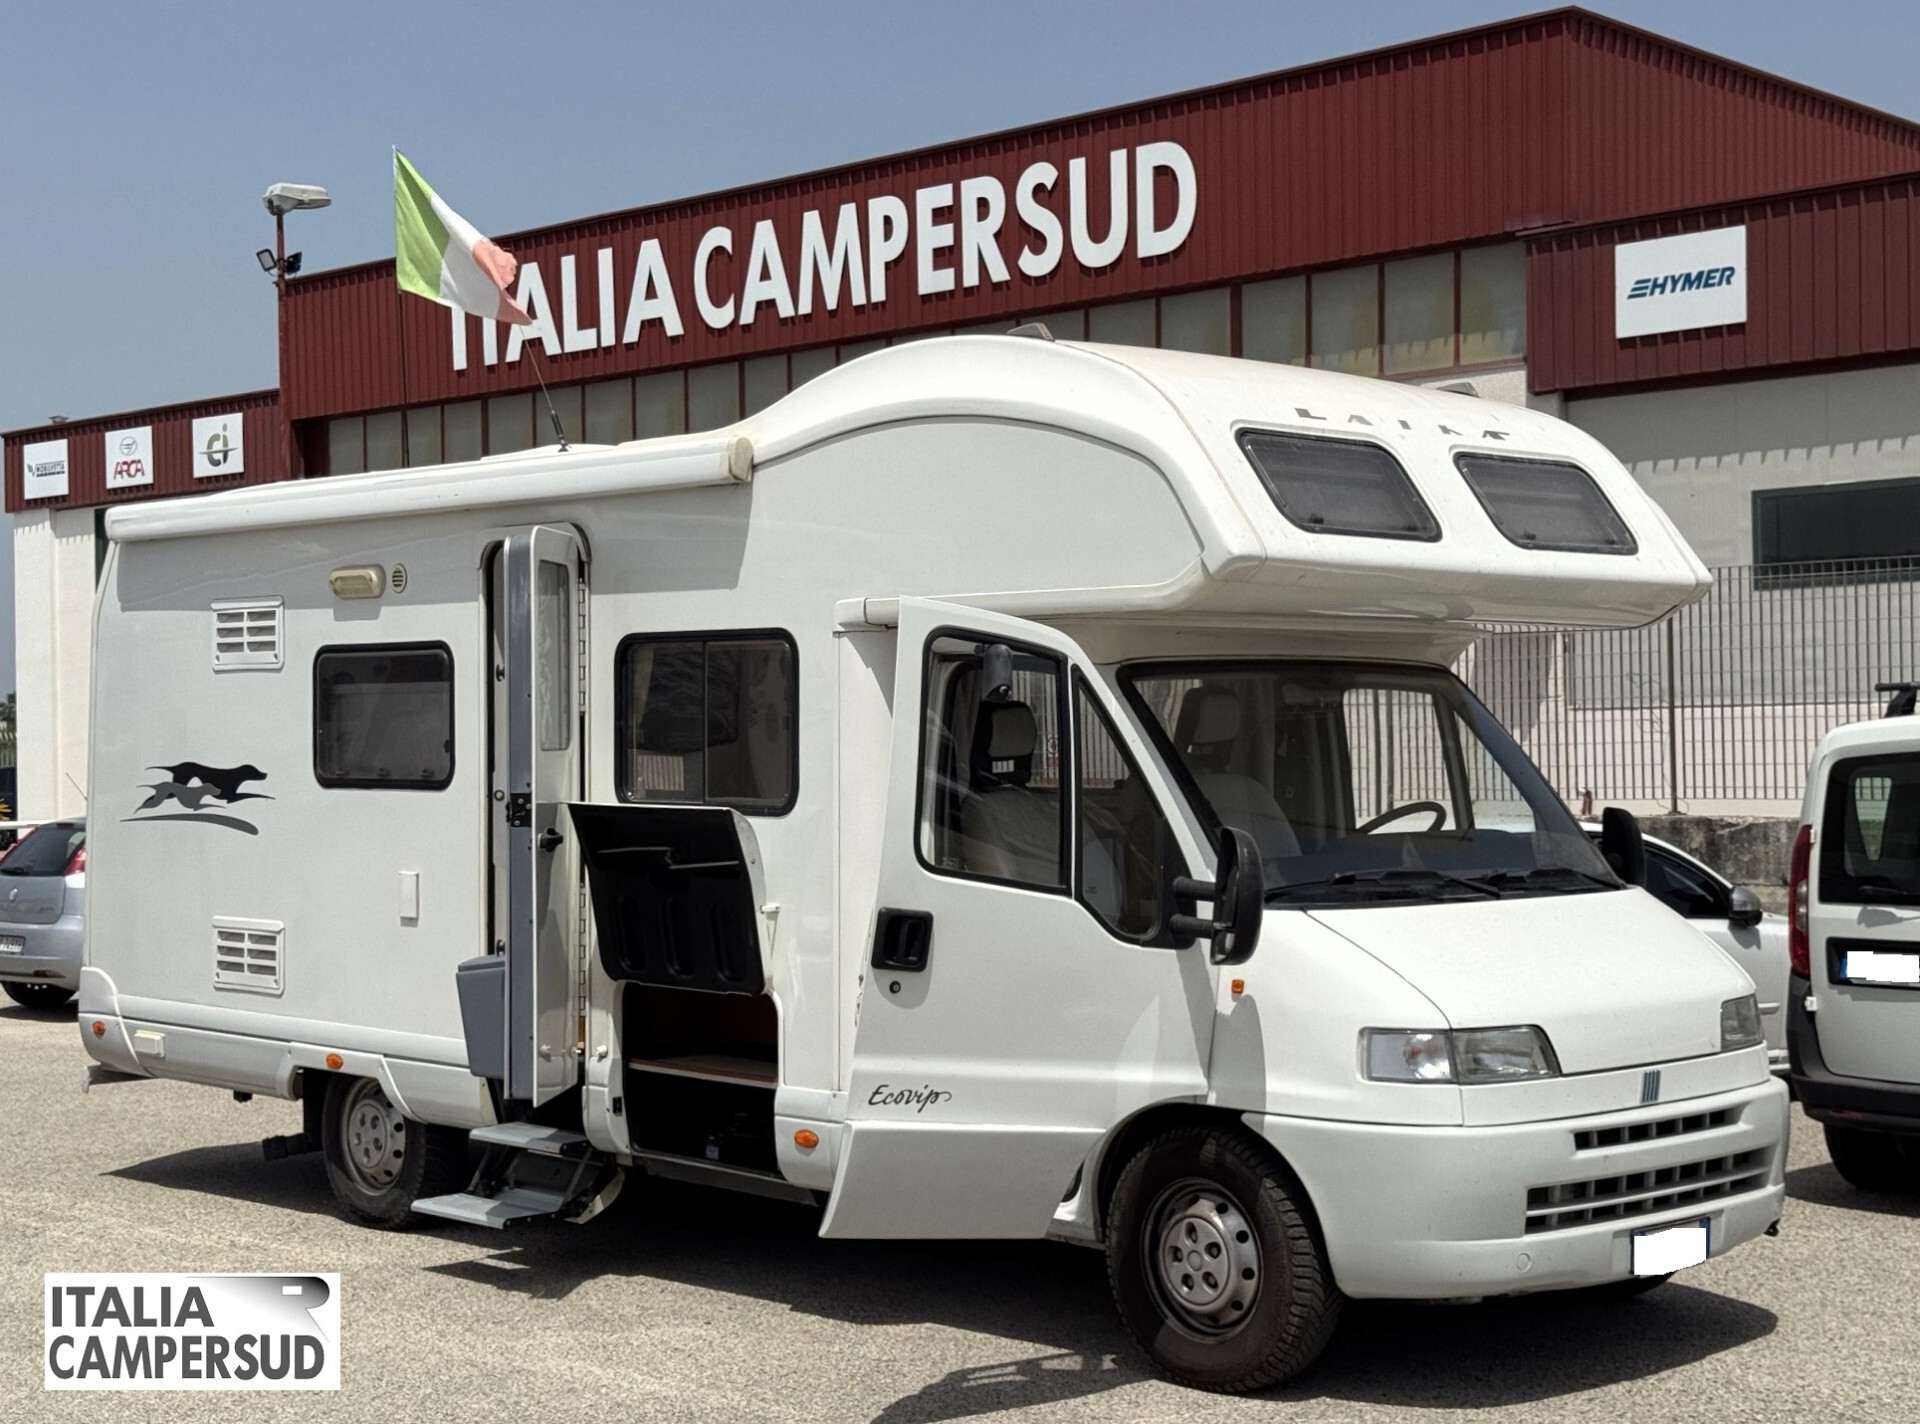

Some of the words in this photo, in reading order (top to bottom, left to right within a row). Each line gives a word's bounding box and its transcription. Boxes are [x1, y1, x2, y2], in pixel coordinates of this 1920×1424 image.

[694, 141, 1198, 330] CAMPERSUD
[1649, 266, 1736, 296] HYMER
[113, 459, 145, 480] ARCA
[868, 1084, 953, 1114] Ecovip
